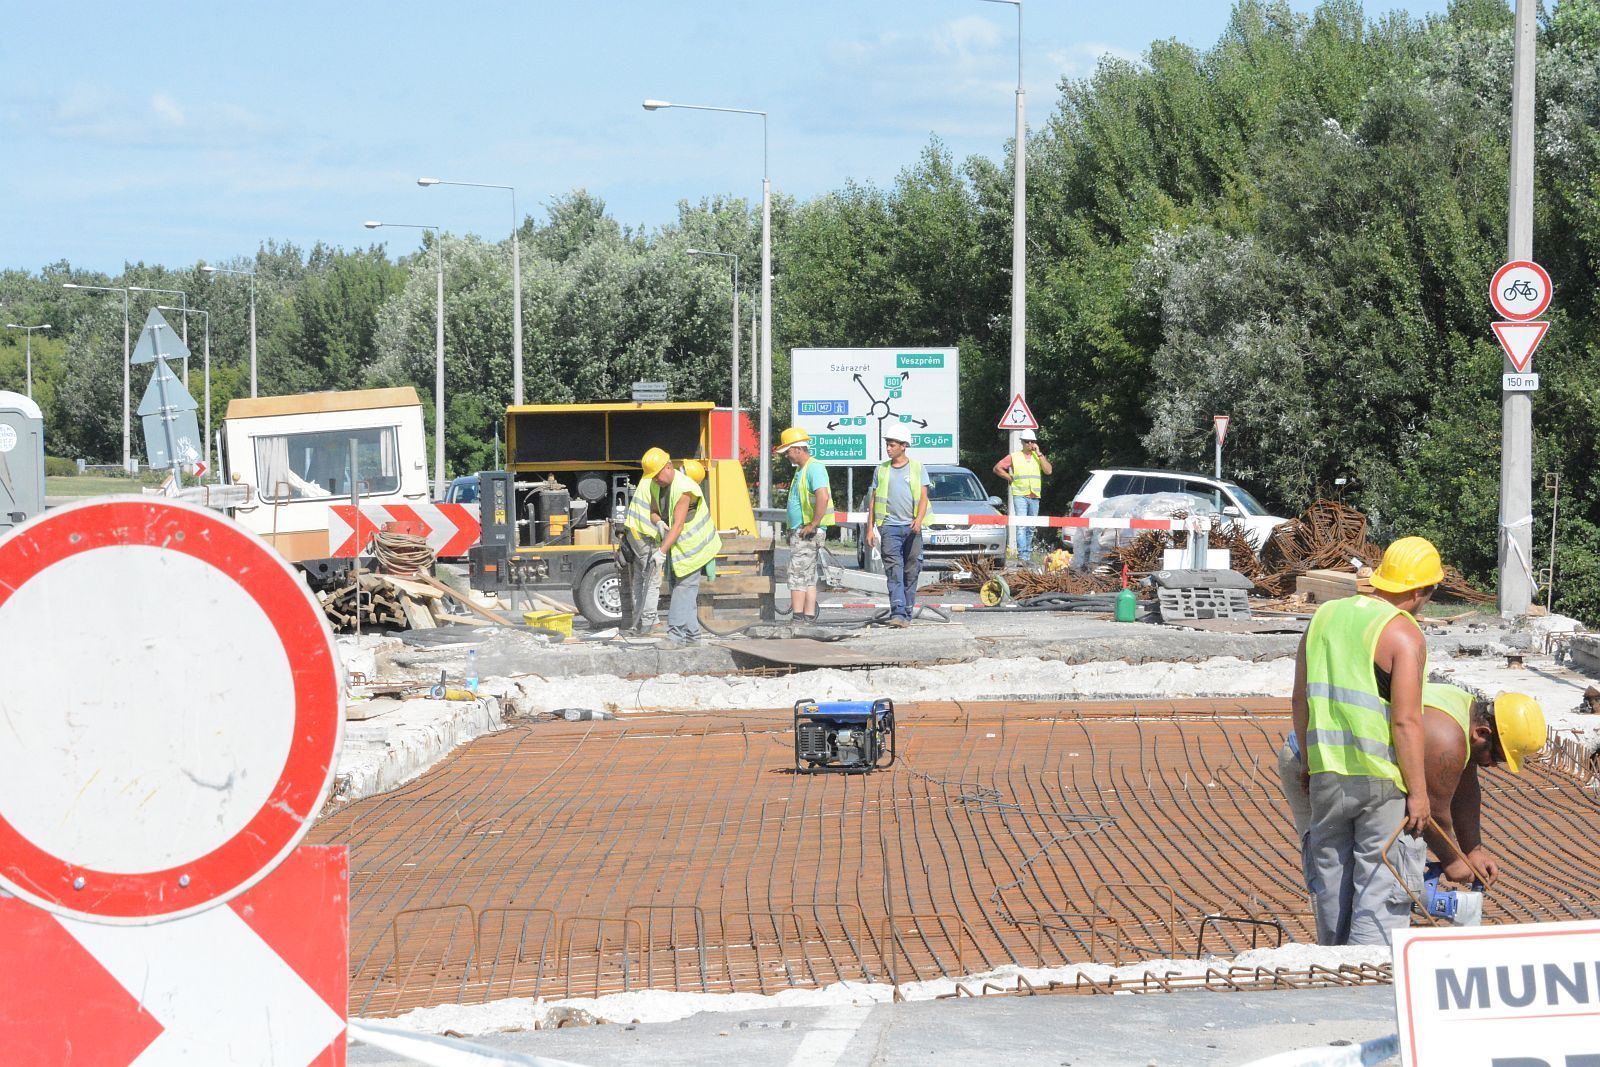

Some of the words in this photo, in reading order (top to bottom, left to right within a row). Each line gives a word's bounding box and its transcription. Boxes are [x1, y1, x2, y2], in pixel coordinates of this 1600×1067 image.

[900, 356, 941, 366] Veszprém
[830, 363, 870, 371] Szárazrét
[887, 378, 899, 386] 801
[1507, 377, 1522, 387] 150
[1524, 379, 1535, 387] m
[819, 436, 863, 446] Dunaújváros
[819, 448, 863, 457] Szekszárd
[1435, 961, 1600, 1010] MUN
